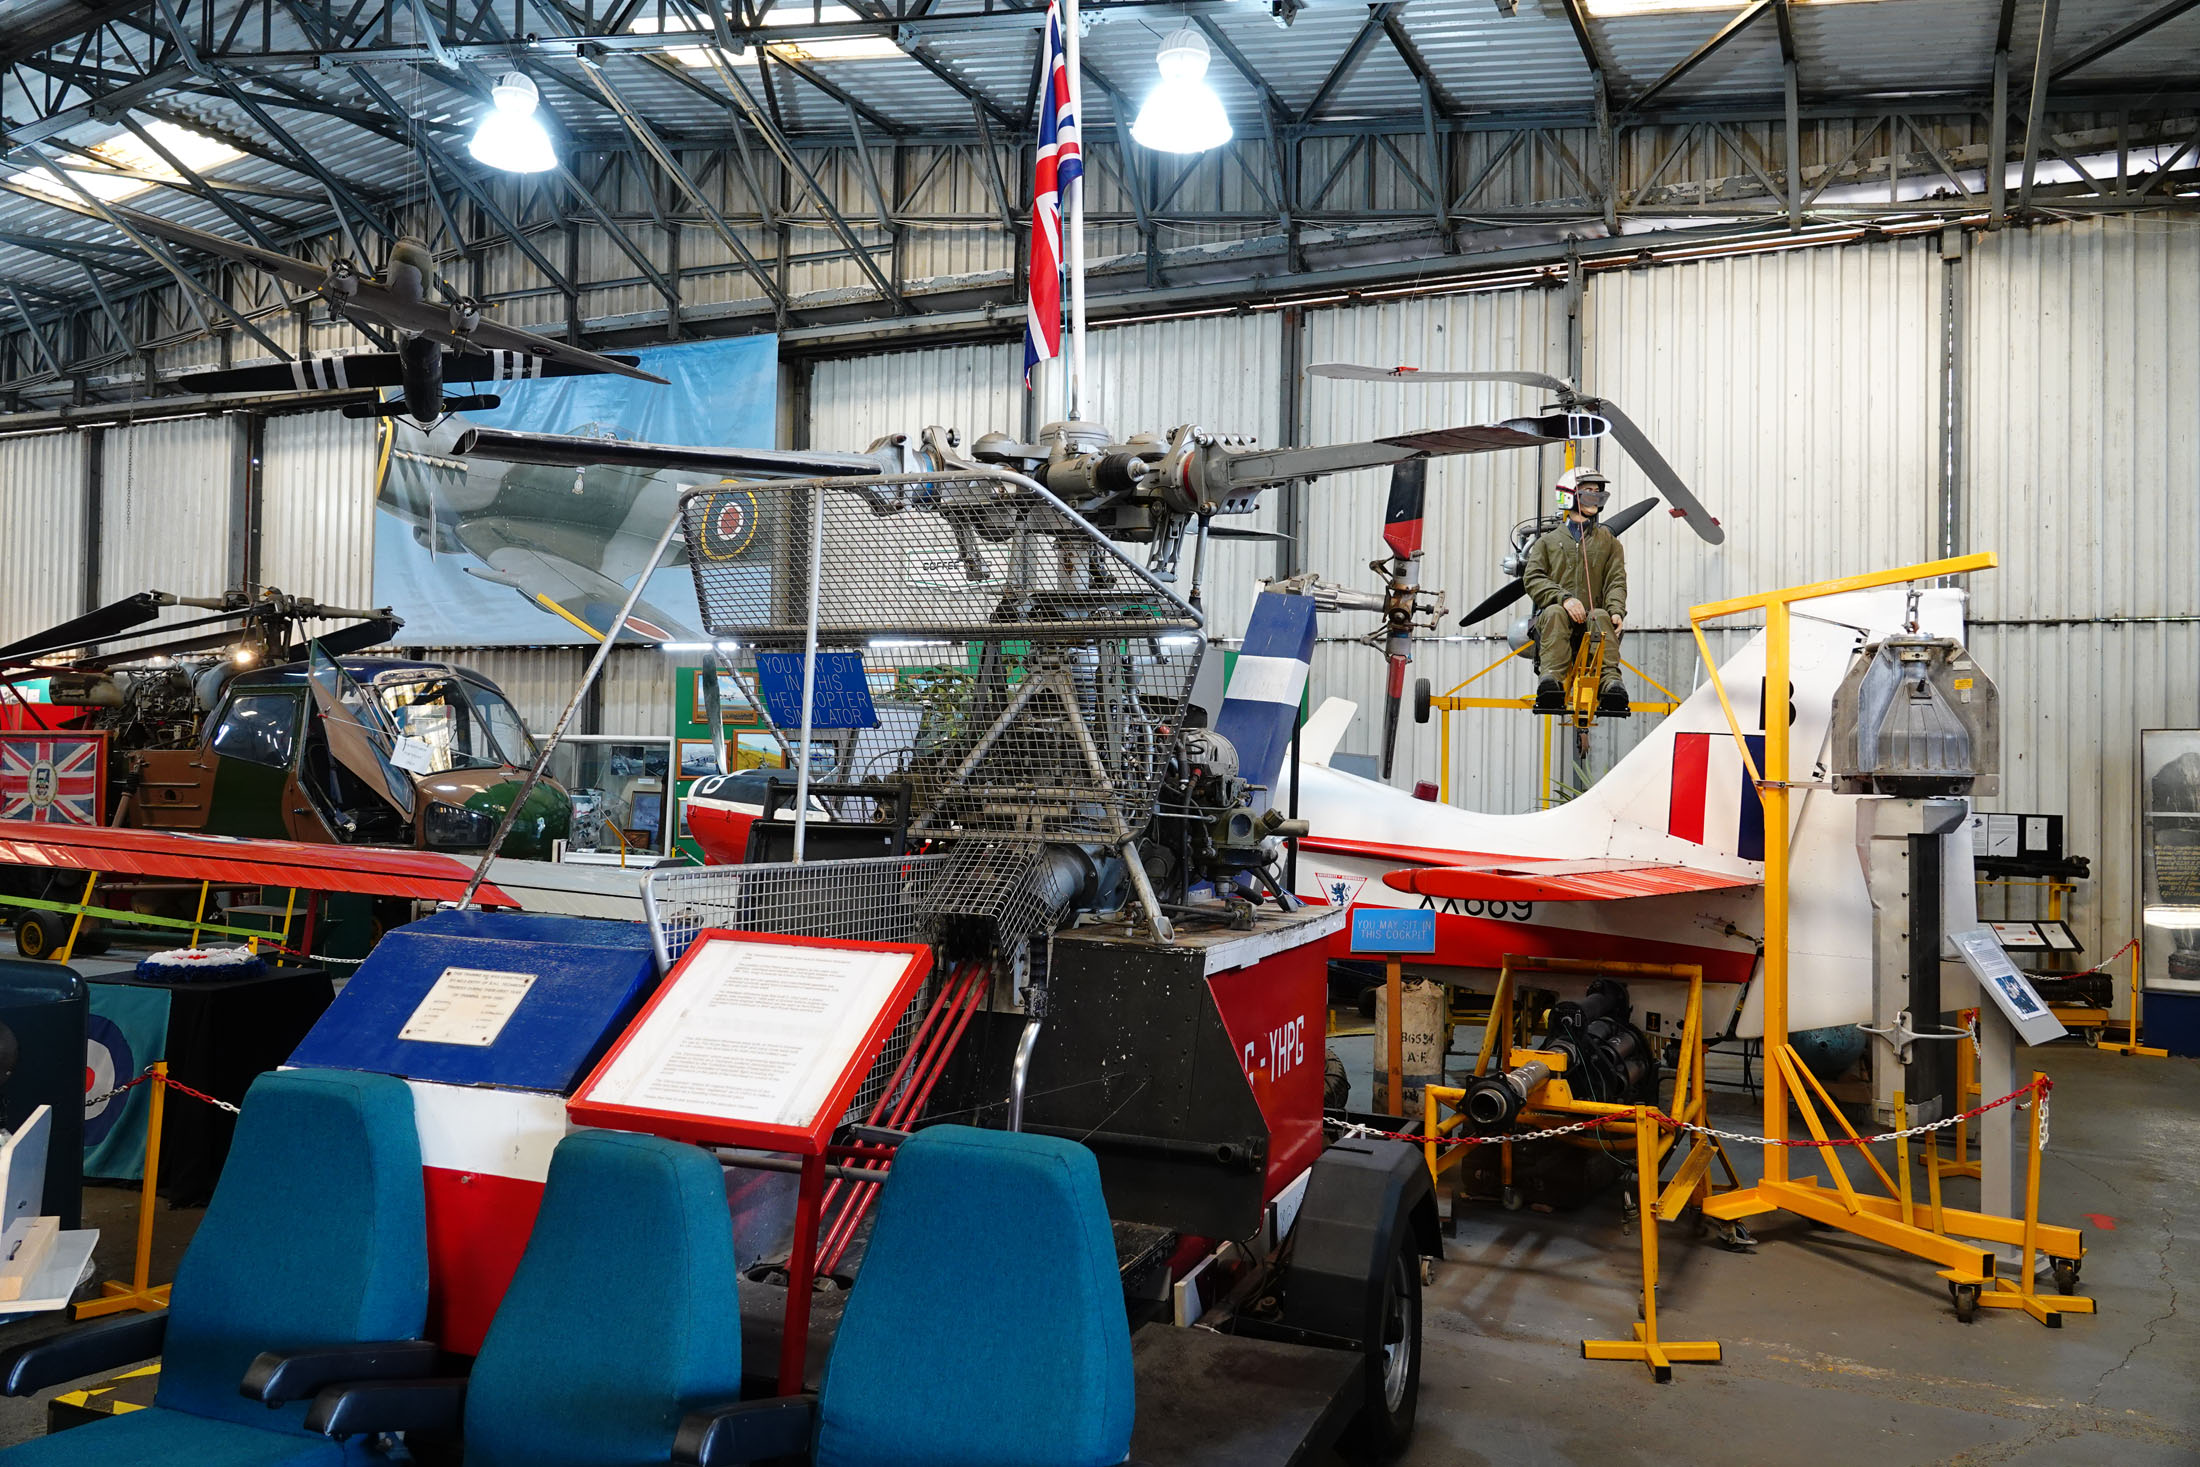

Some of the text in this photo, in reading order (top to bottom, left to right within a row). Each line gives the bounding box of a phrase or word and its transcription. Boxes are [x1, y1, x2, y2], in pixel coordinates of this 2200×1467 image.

[922, 560, 961, 571] COFFEE
[762, 656, 792, 674] YOU
[832, 655, 854, 673] SIT
[784, 673, 844, 691] IN HIS
[768, 691, 869, 708] HELIOPTER
[1357, 919, 1432, 931] YOU MAY SIT IN
[1360, 929, 1427, 941] THIS COCKPIT
